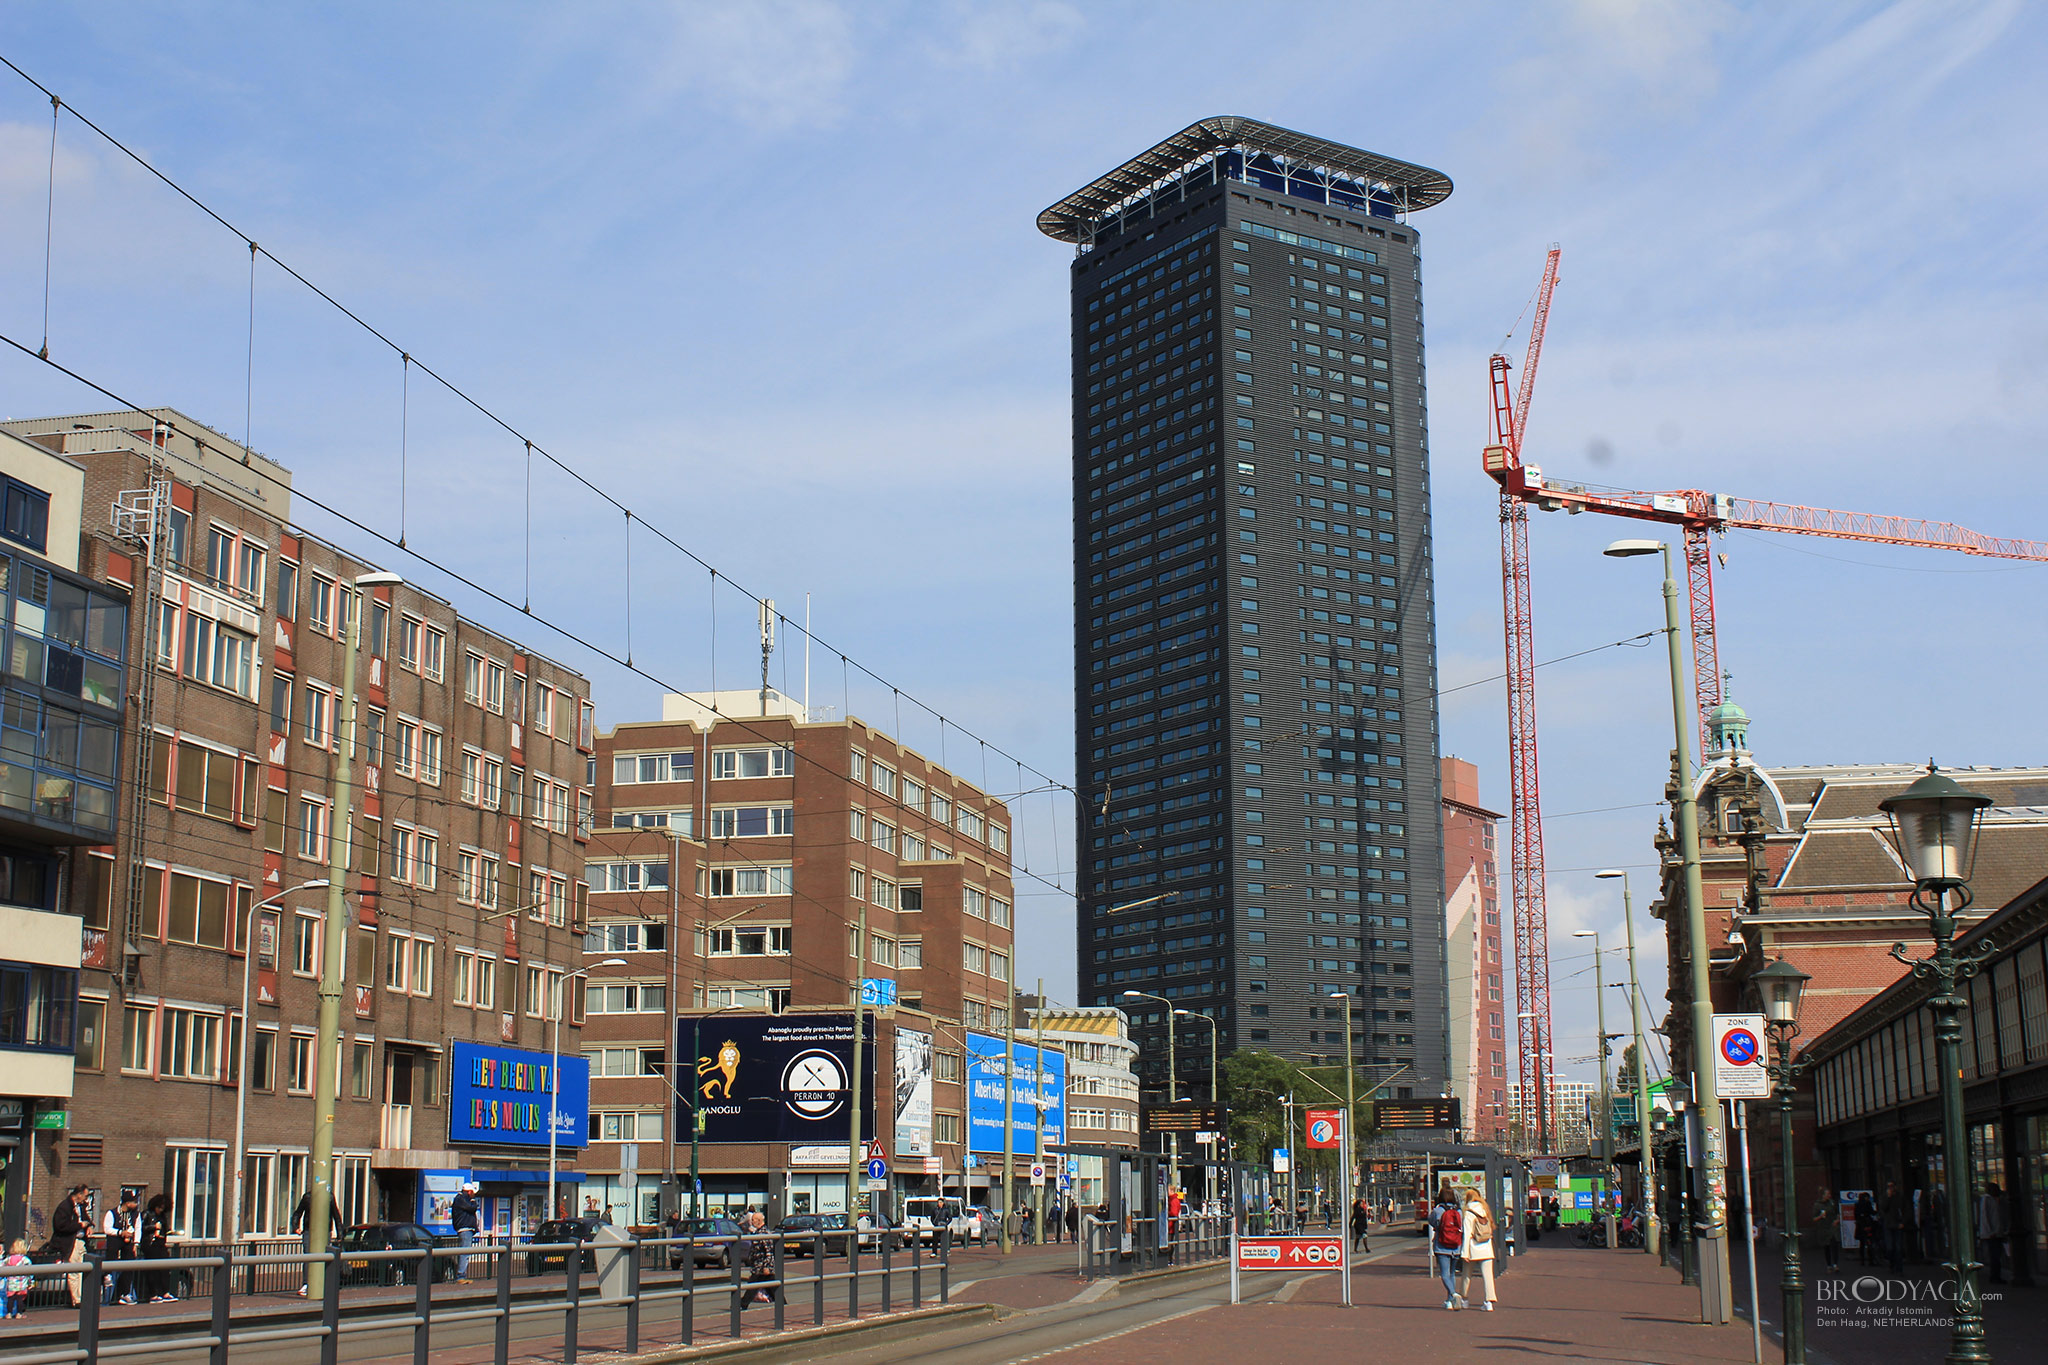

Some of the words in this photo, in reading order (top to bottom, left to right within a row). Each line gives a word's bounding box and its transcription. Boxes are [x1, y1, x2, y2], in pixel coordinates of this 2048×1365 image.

[792, 1026, 812, 1034] proudly
[1727, 1018, 1750, 1026] ZONE
[472, 1057, 497, 1088] HET
[500, 1060, 536, 1092] BEGIN
[794, 1092, 823, 1101] PERRON
[826, 1092, 836, 1100] 10
[974, 1079, 992, 1099] Albert
[1015, 1086, 1025, 1104] het
[470, 1098, 498, 1129] IETS
[501, 1102, 541, 1132] MOOIS
